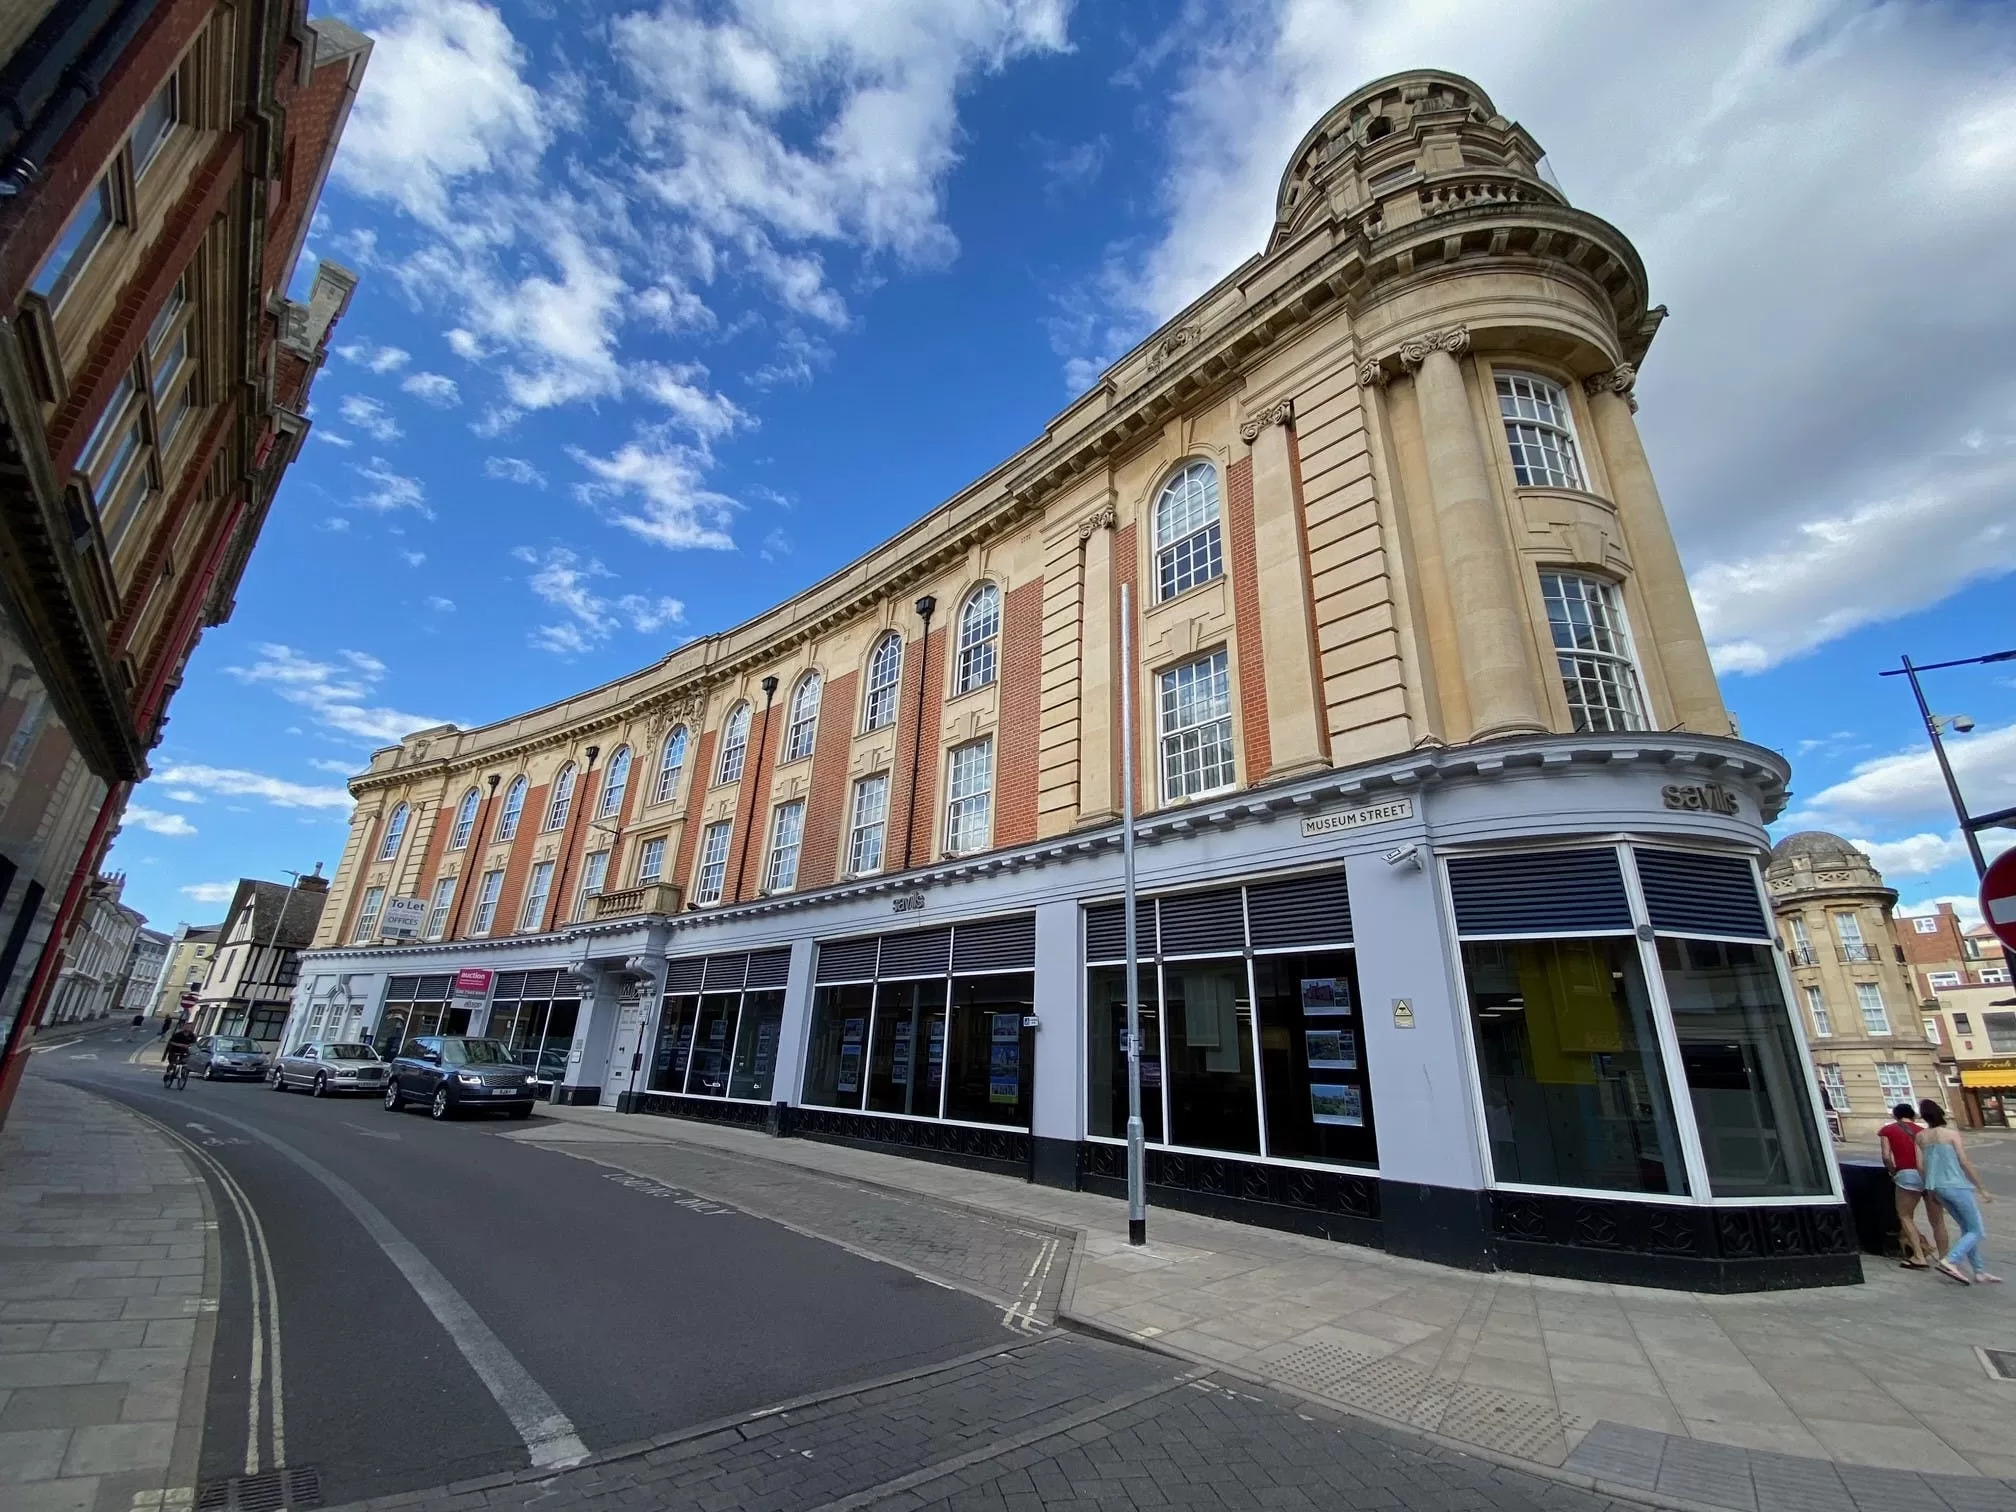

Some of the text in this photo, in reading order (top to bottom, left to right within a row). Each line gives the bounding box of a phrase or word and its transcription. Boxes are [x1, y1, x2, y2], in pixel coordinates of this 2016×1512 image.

[1661, 783, 1740, 816] savills
[1306, 804, 1406, 832] MUSEUM STREET
[391, 898, 425, 911] To Let
[892, 890, 926, 913] savills
[387, 916, 419, 926] OFFICES
[460, 971, 486, 980] auction
[672, 1198, 737, 1215] ONLY
